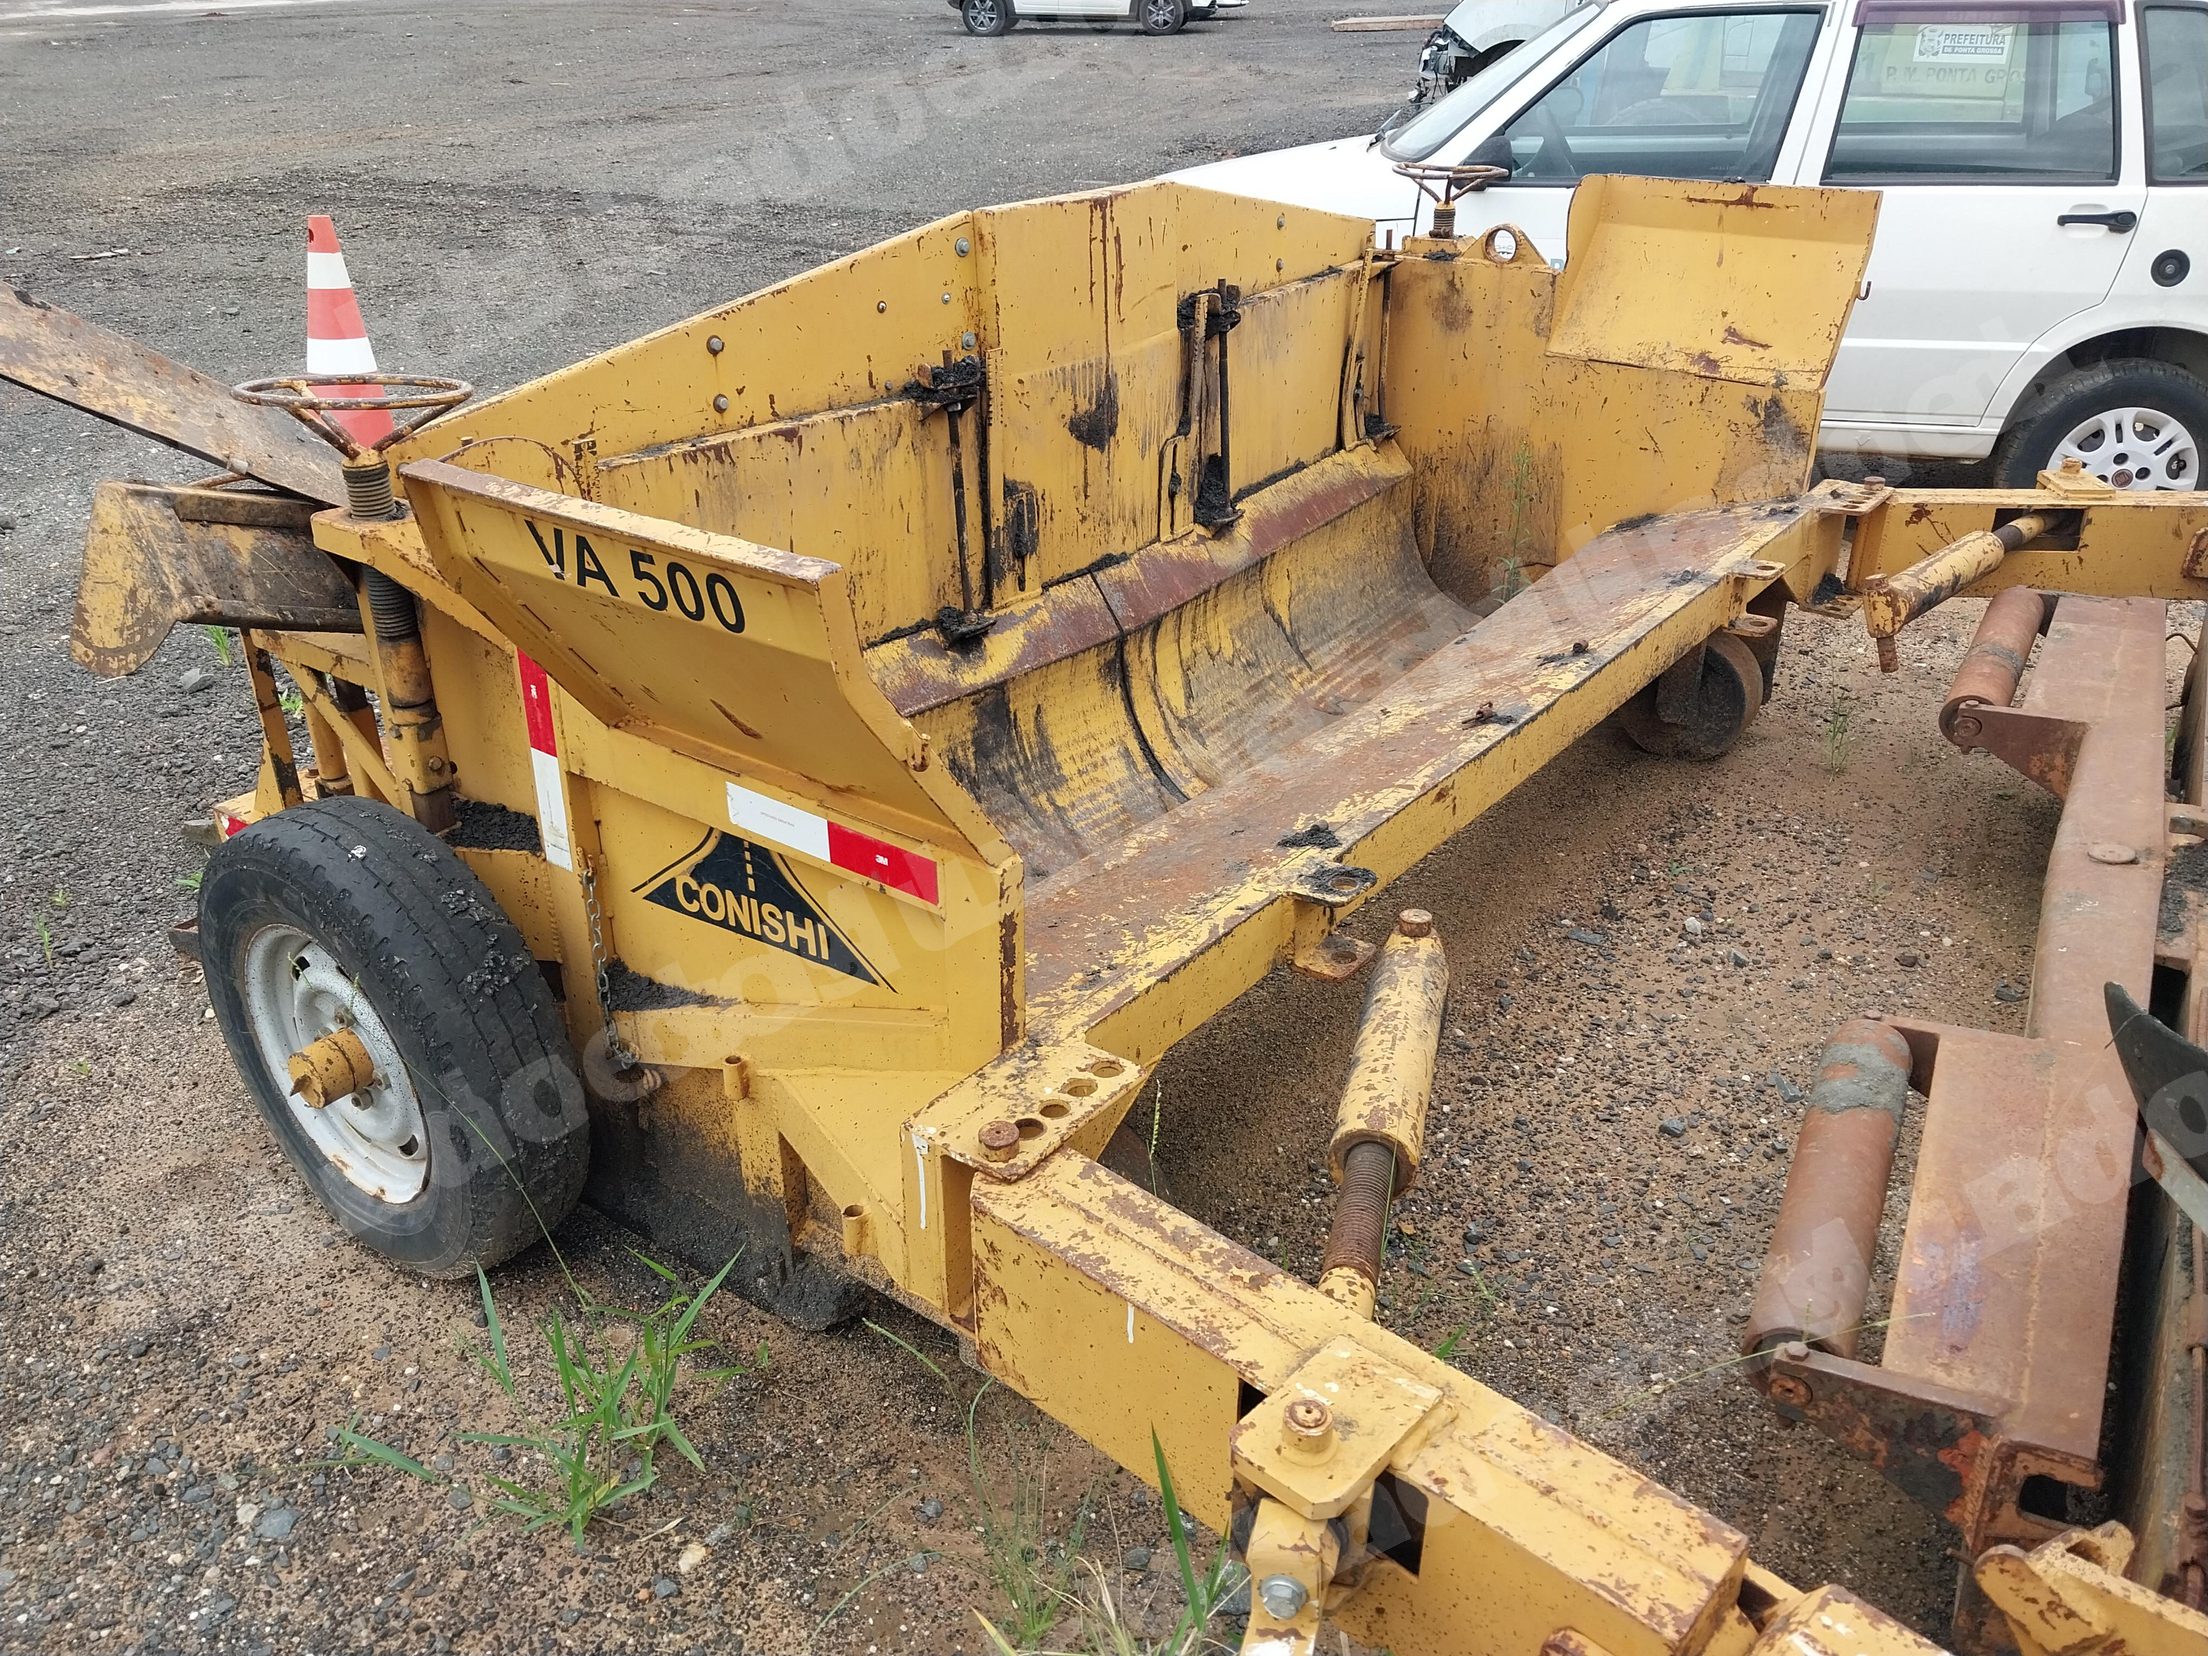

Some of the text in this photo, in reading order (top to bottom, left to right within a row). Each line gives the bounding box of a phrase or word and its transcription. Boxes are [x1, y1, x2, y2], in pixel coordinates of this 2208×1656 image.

[1943, 33, 2006, 46] PREFEITURA
[1954, 46, 1976, 54] PONTA
[523, 519, 746, 634] VA 500
[675, 874, 830, 961] CONISHI
